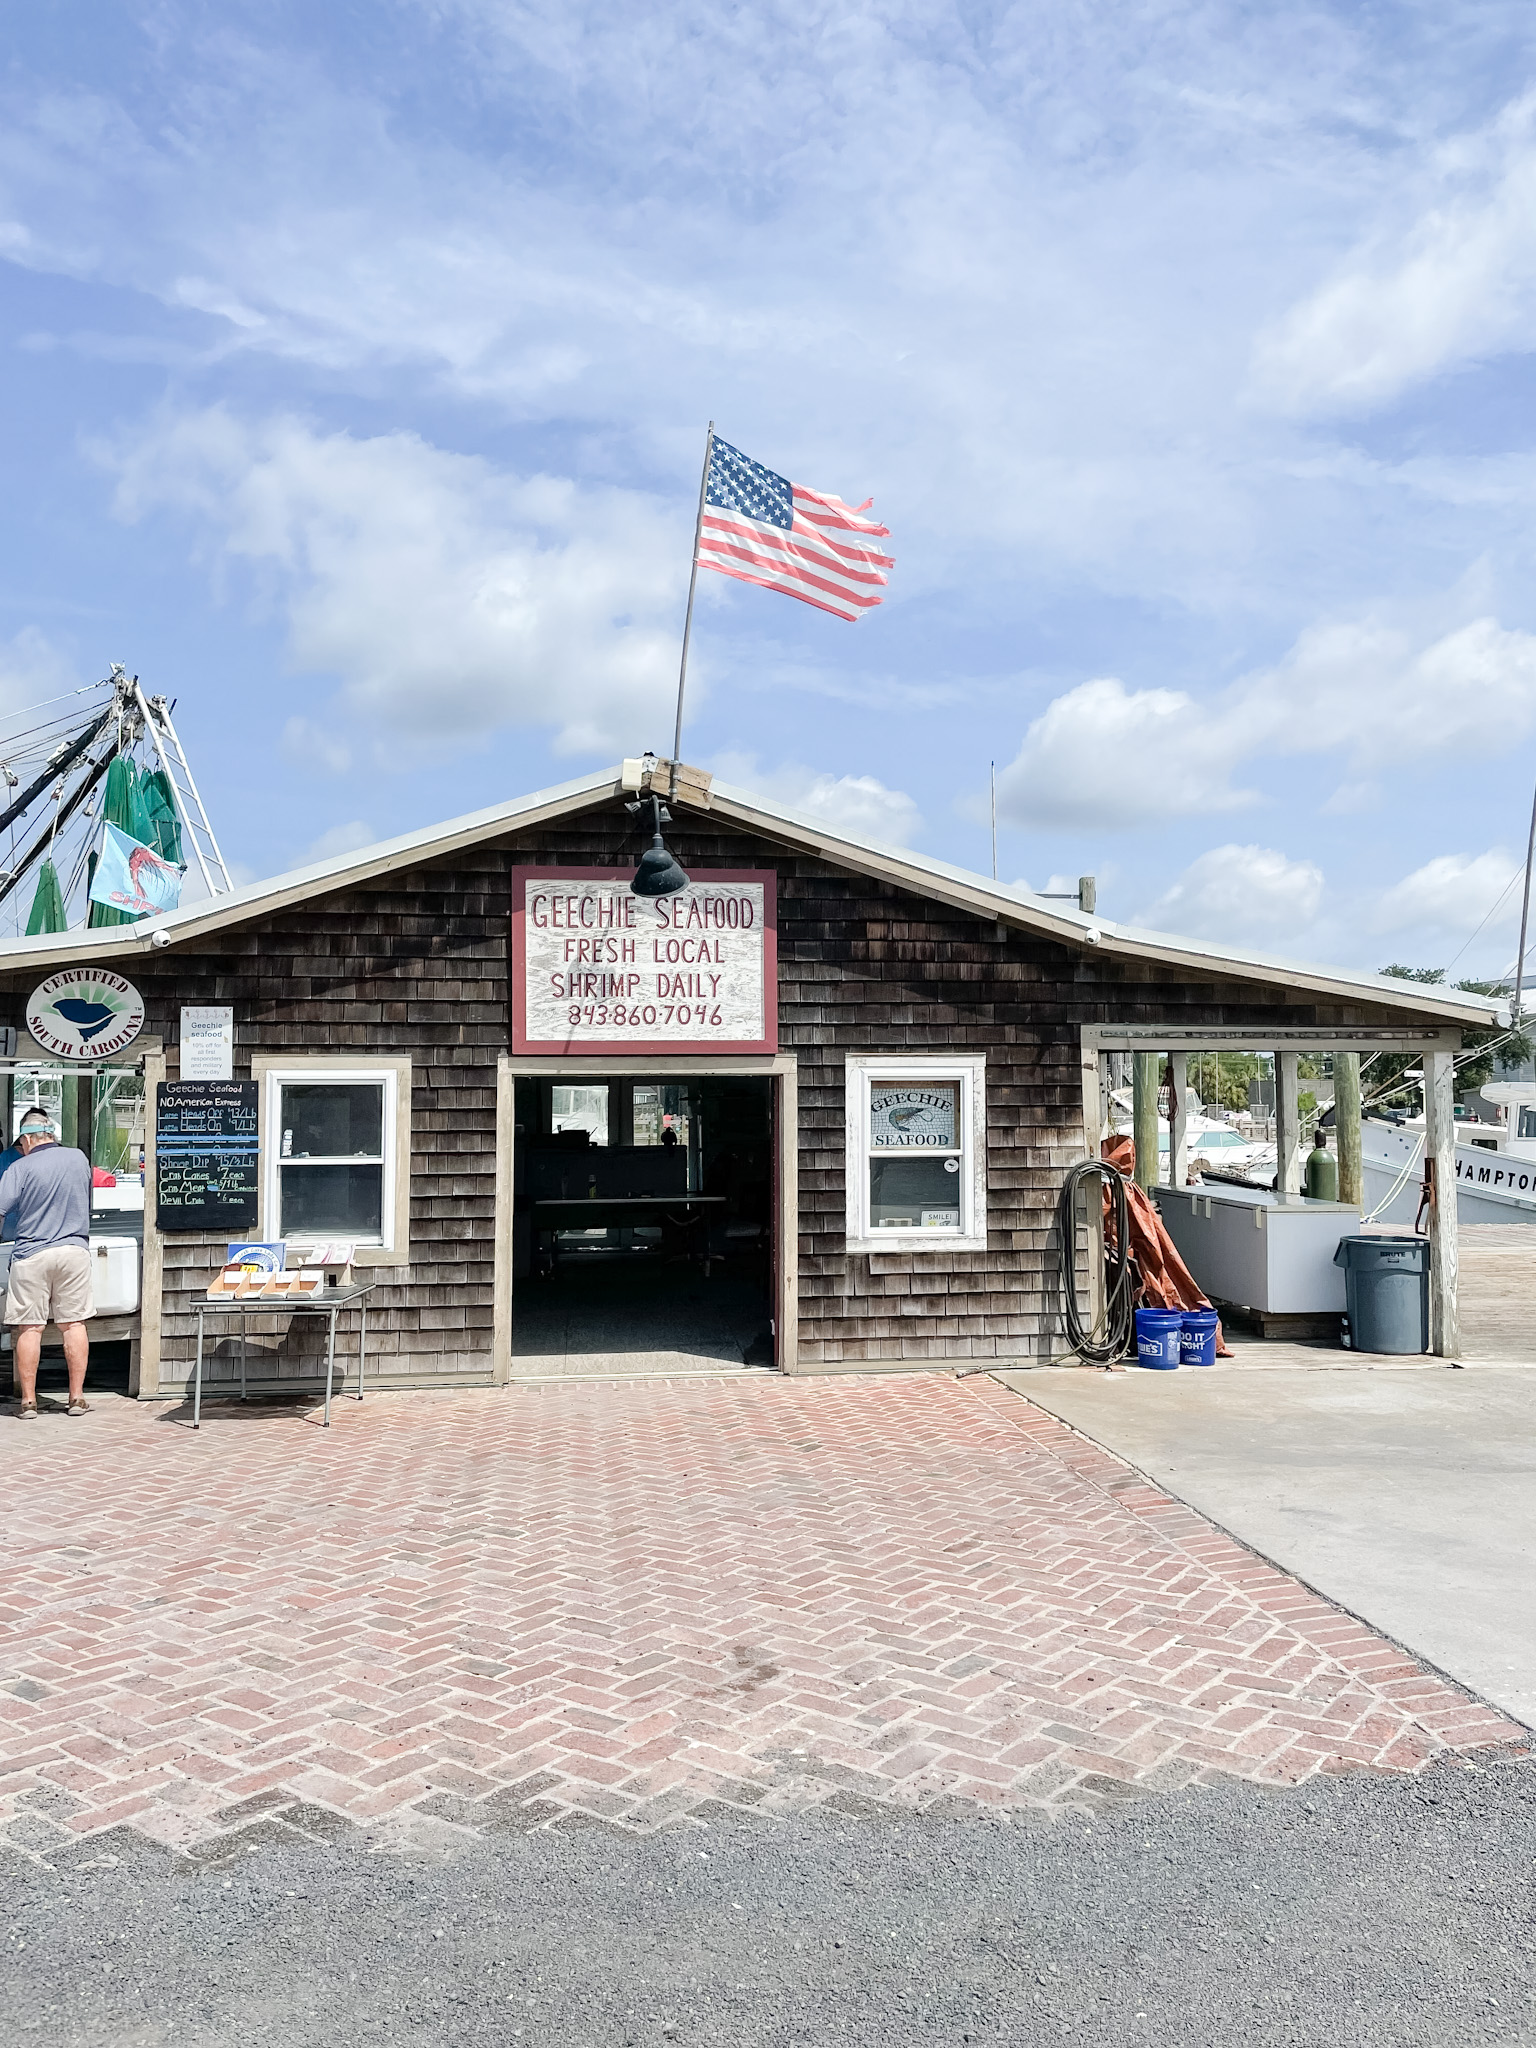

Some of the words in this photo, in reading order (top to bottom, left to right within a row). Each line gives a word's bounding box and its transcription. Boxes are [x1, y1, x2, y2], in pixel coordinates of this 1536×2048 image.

[531, 895, 637, 929] GEECHIE
[655, 897, 754, 930] SEAFOOD
[563, 937, 636, 964] FRESH
[653, 938, 726, 964] LOCAL
[42, 970, 129, 994] CERTIFIED
[550, 972, 641, 999] SHRIMP
[658, 973, 722, 998] DAILY
[29, 1016, 73, 1055] SOUTH
[79, 1014, 142, 1057] CAROLINA
[166, 1081, 205, 1093] Geechie
[208, 1082, 242, 1093] Seafood
[214, 1097, 241, 1107] Express
[871, 1092, 953, 1113] GEECHIE
[875, 1134, 949, 1146] SEAFOOD
[1455, 1159, 1536, 1192] HAMPTO
[1195, 1333, 1205, 1341] IT
